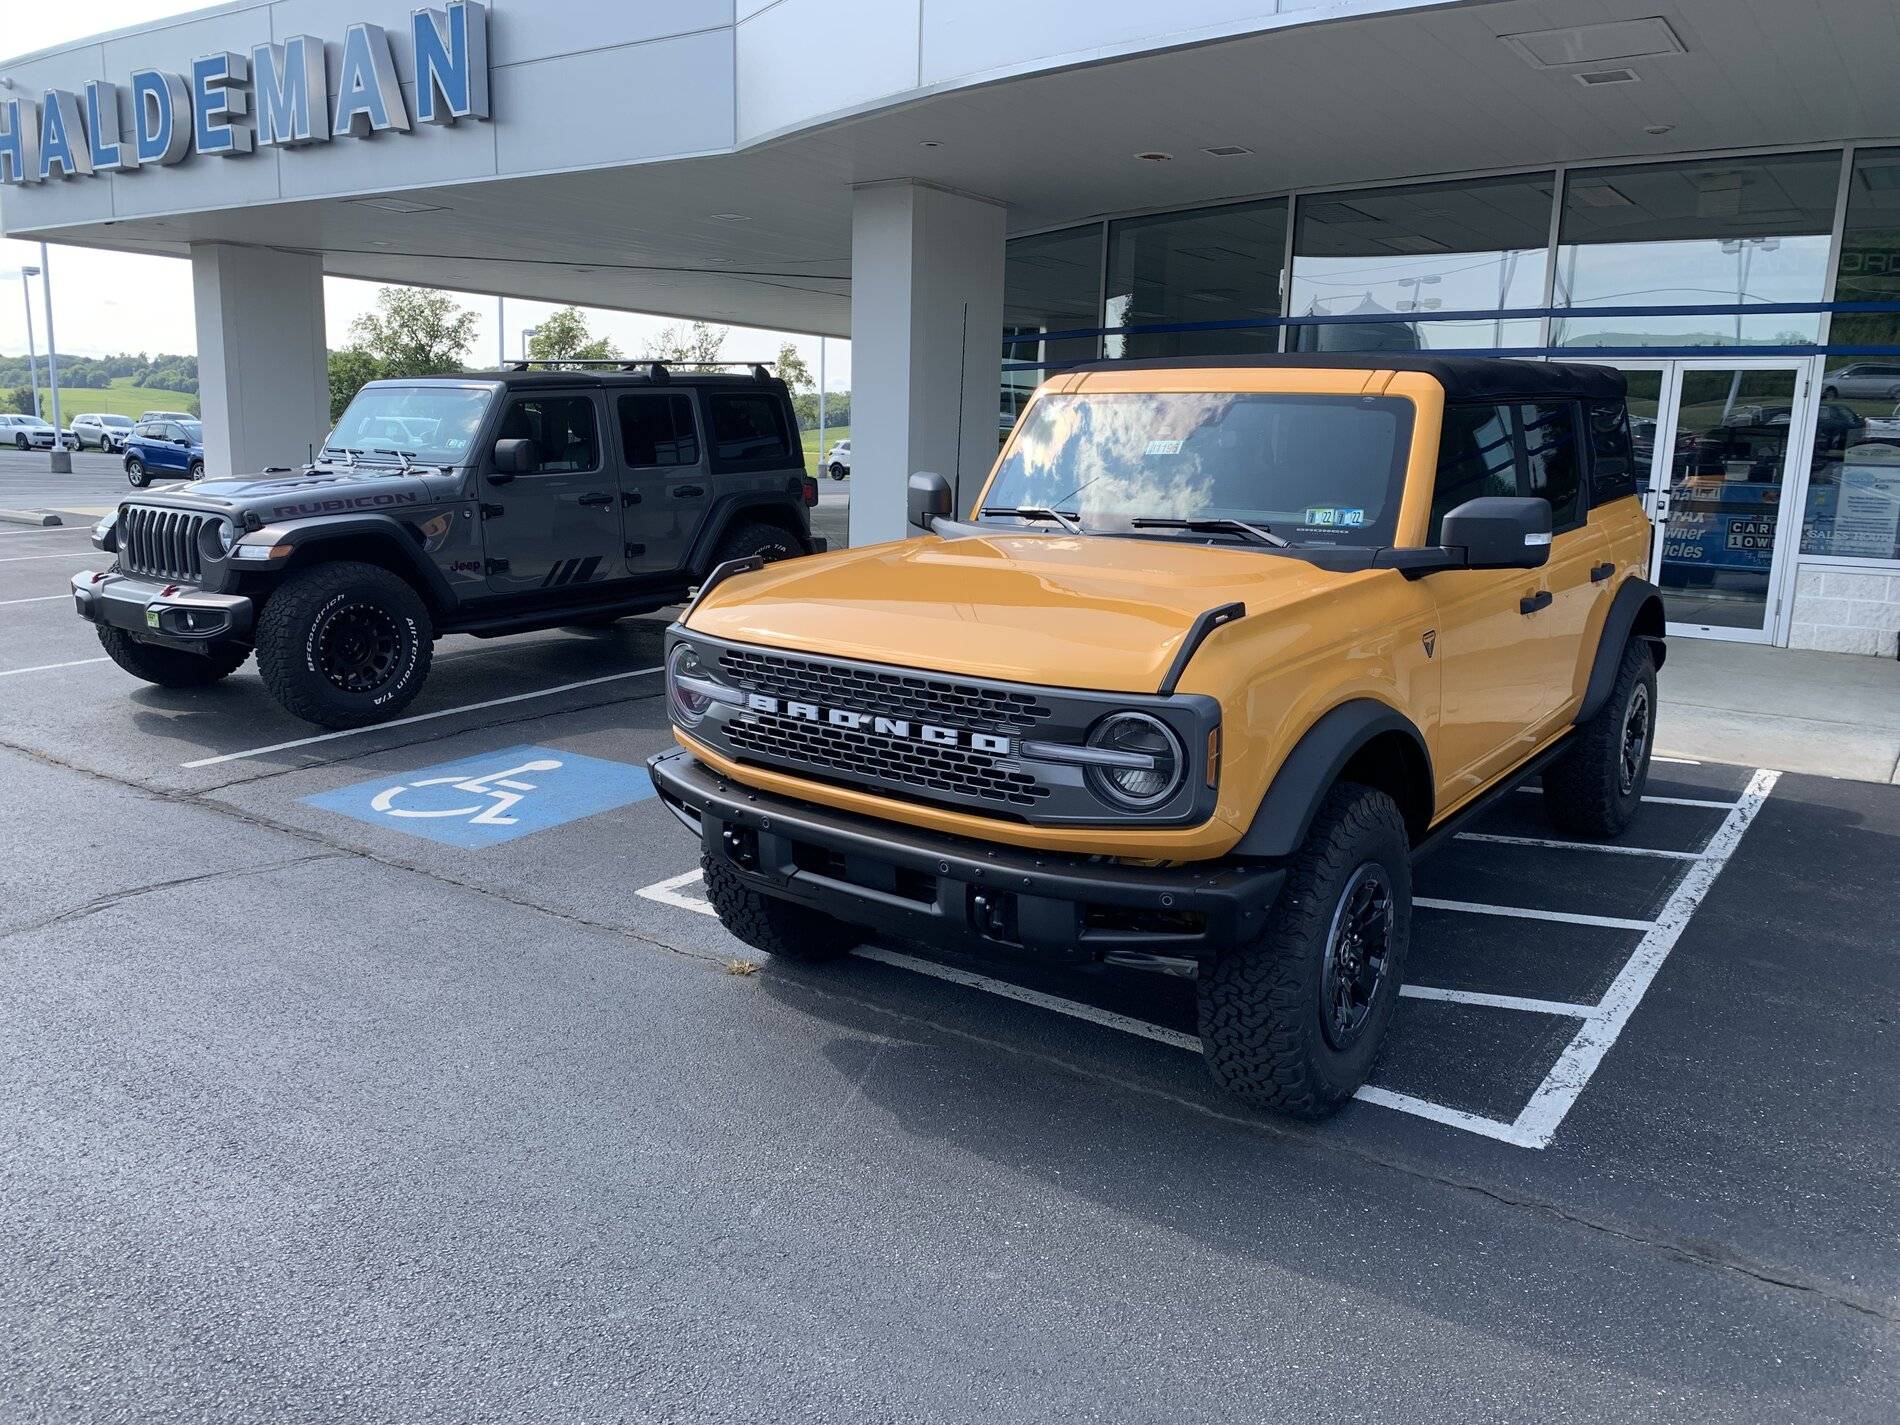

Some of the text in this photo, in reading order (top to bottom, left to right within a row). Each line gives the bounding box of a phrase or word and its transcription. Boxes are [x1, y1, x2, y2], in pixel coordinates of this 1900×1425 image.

[0, 1, 484, 184] HALDEMAN
[273, 492, 416, 518] RUBICON
[1664, 527, 1706, 541] wner
[1732, 522, 1777, 534] CAR
[1663, 541, 1704, 559] icles
[451, 561, 480, 572] Jeep
[306, 594, 345, 672] BFGoodrich
[373, 617, 419, 705] All-Terrain T/A
[748, 693, 1010, 755] BRONCO
